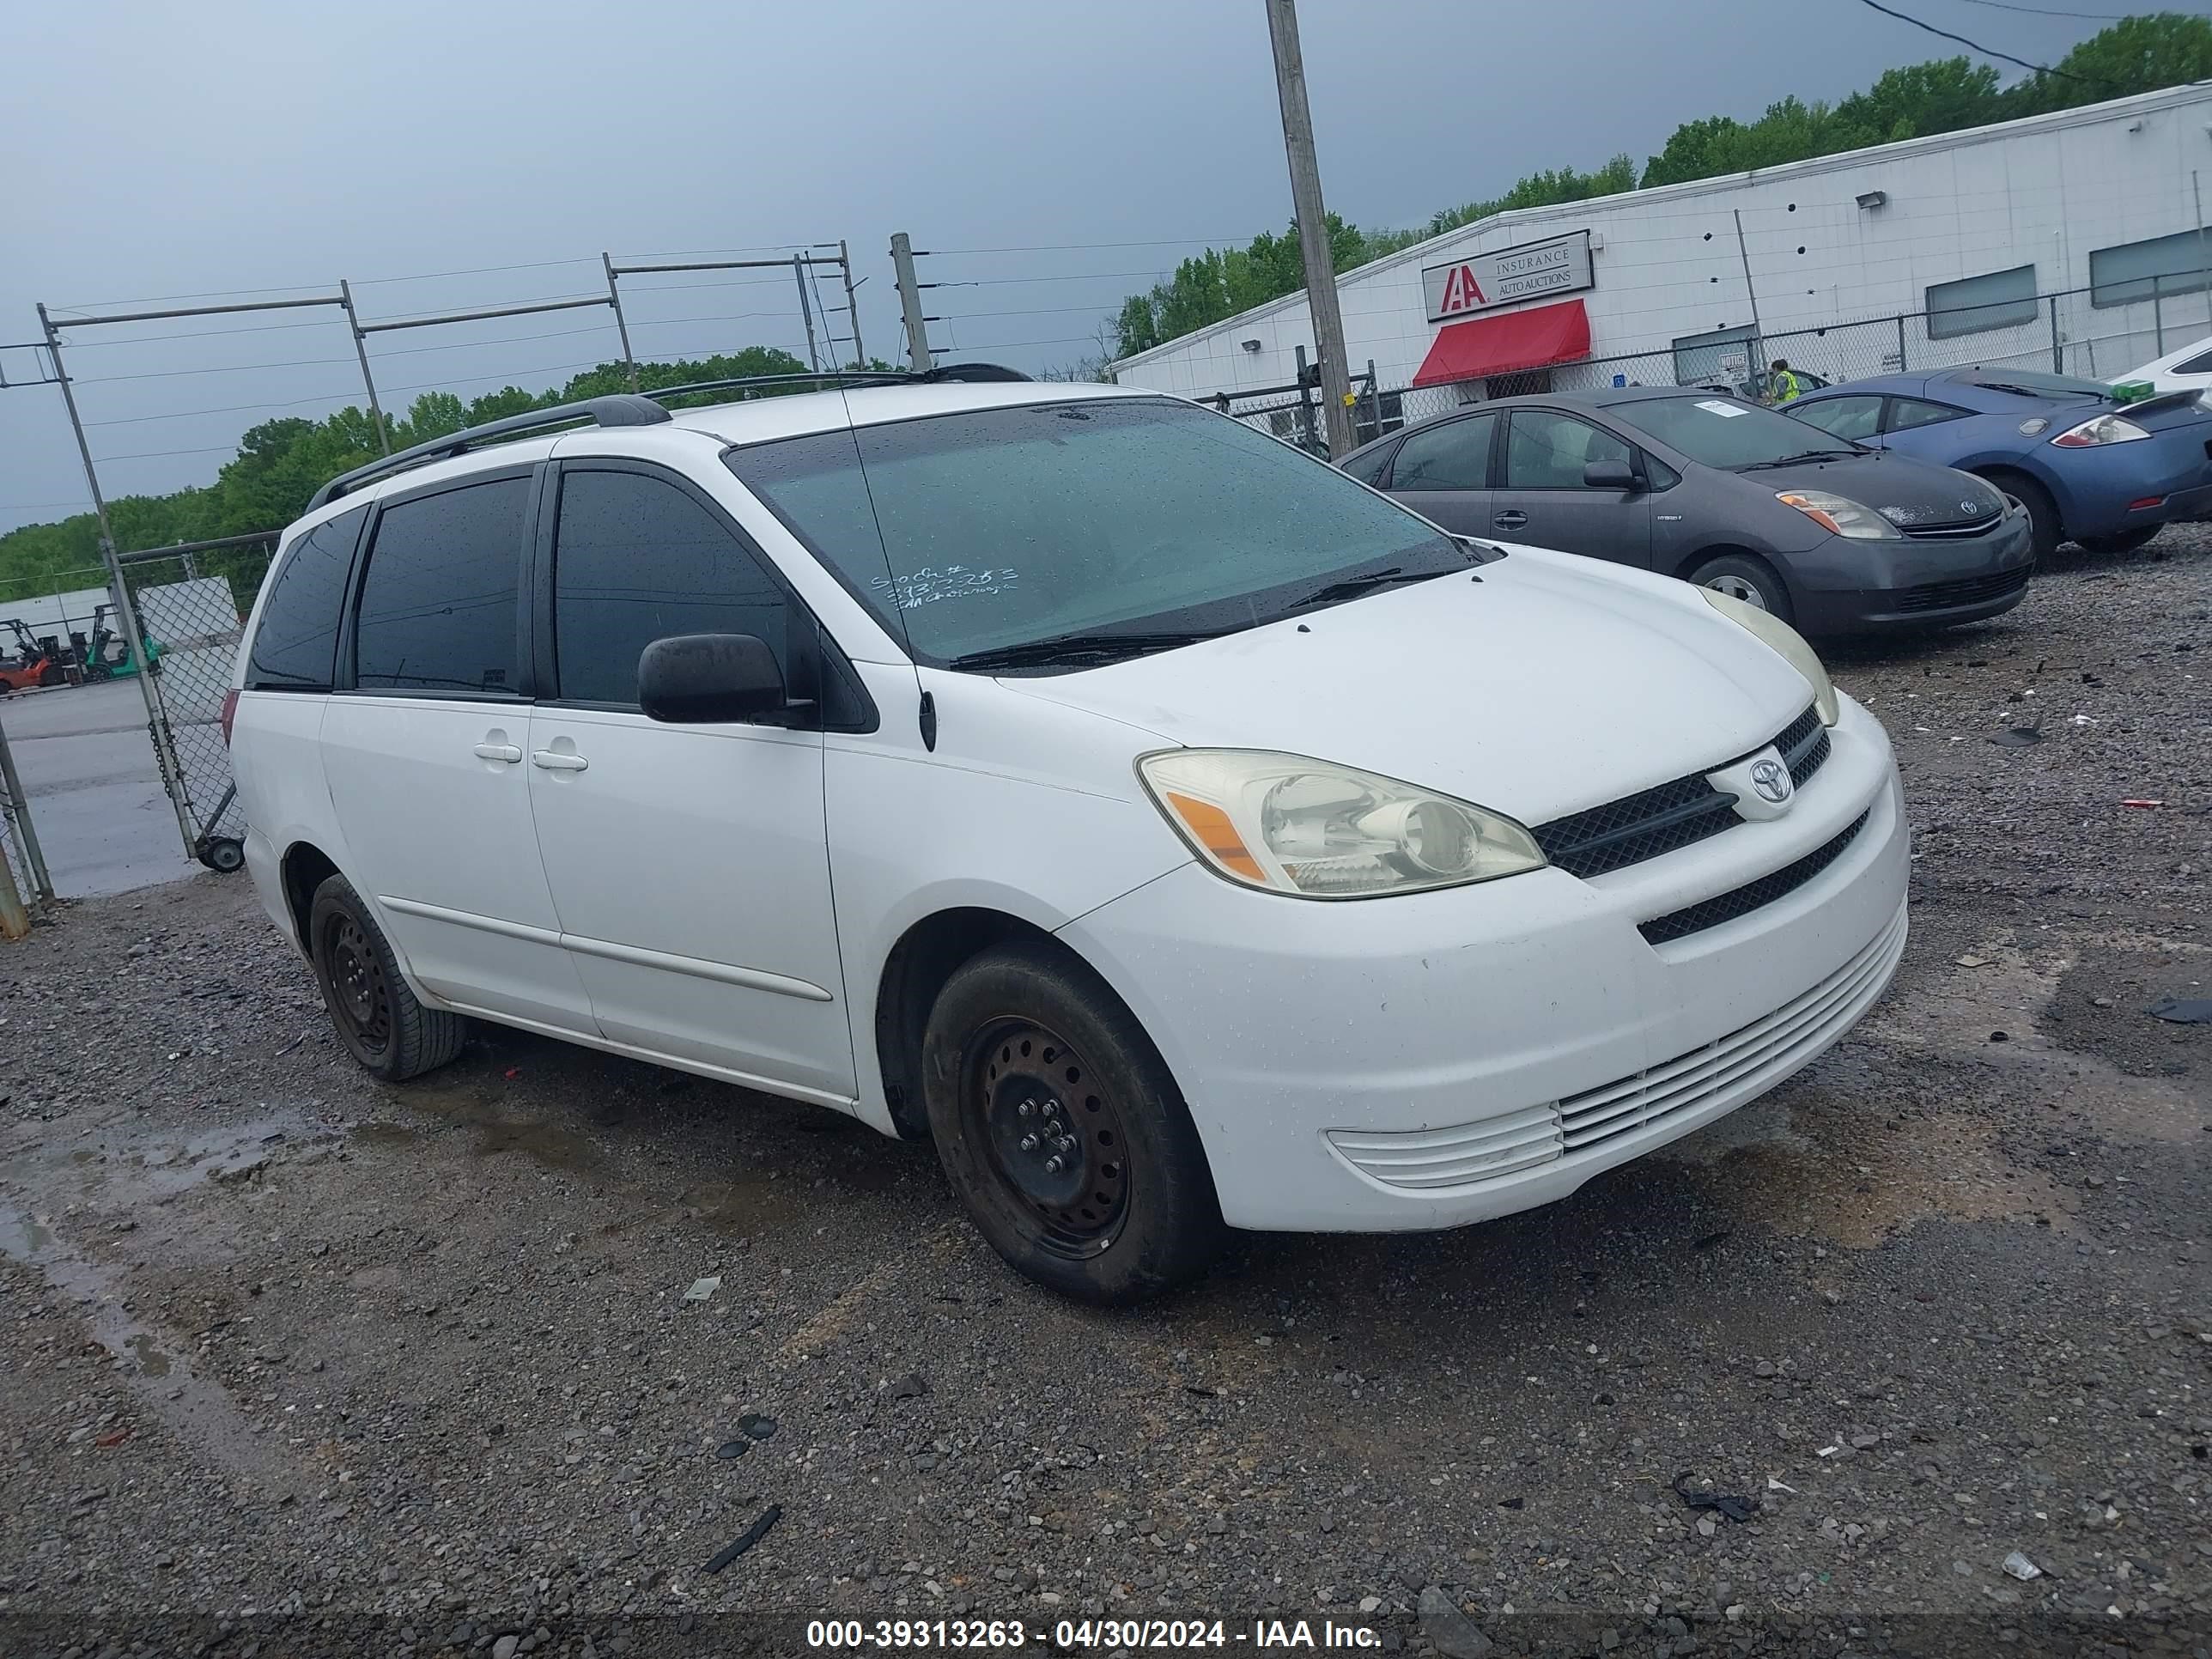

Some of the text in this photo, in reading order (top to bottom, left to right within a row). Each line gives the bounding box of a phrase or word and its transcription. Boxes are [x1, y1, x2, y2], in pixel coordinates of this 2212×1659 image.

[1497, 248, 1570, 275] INSURANCE
[1498, 270, 1571, 295] AUTO AUCTIONS
[1721, 354, 1746, 368] NOTICE
